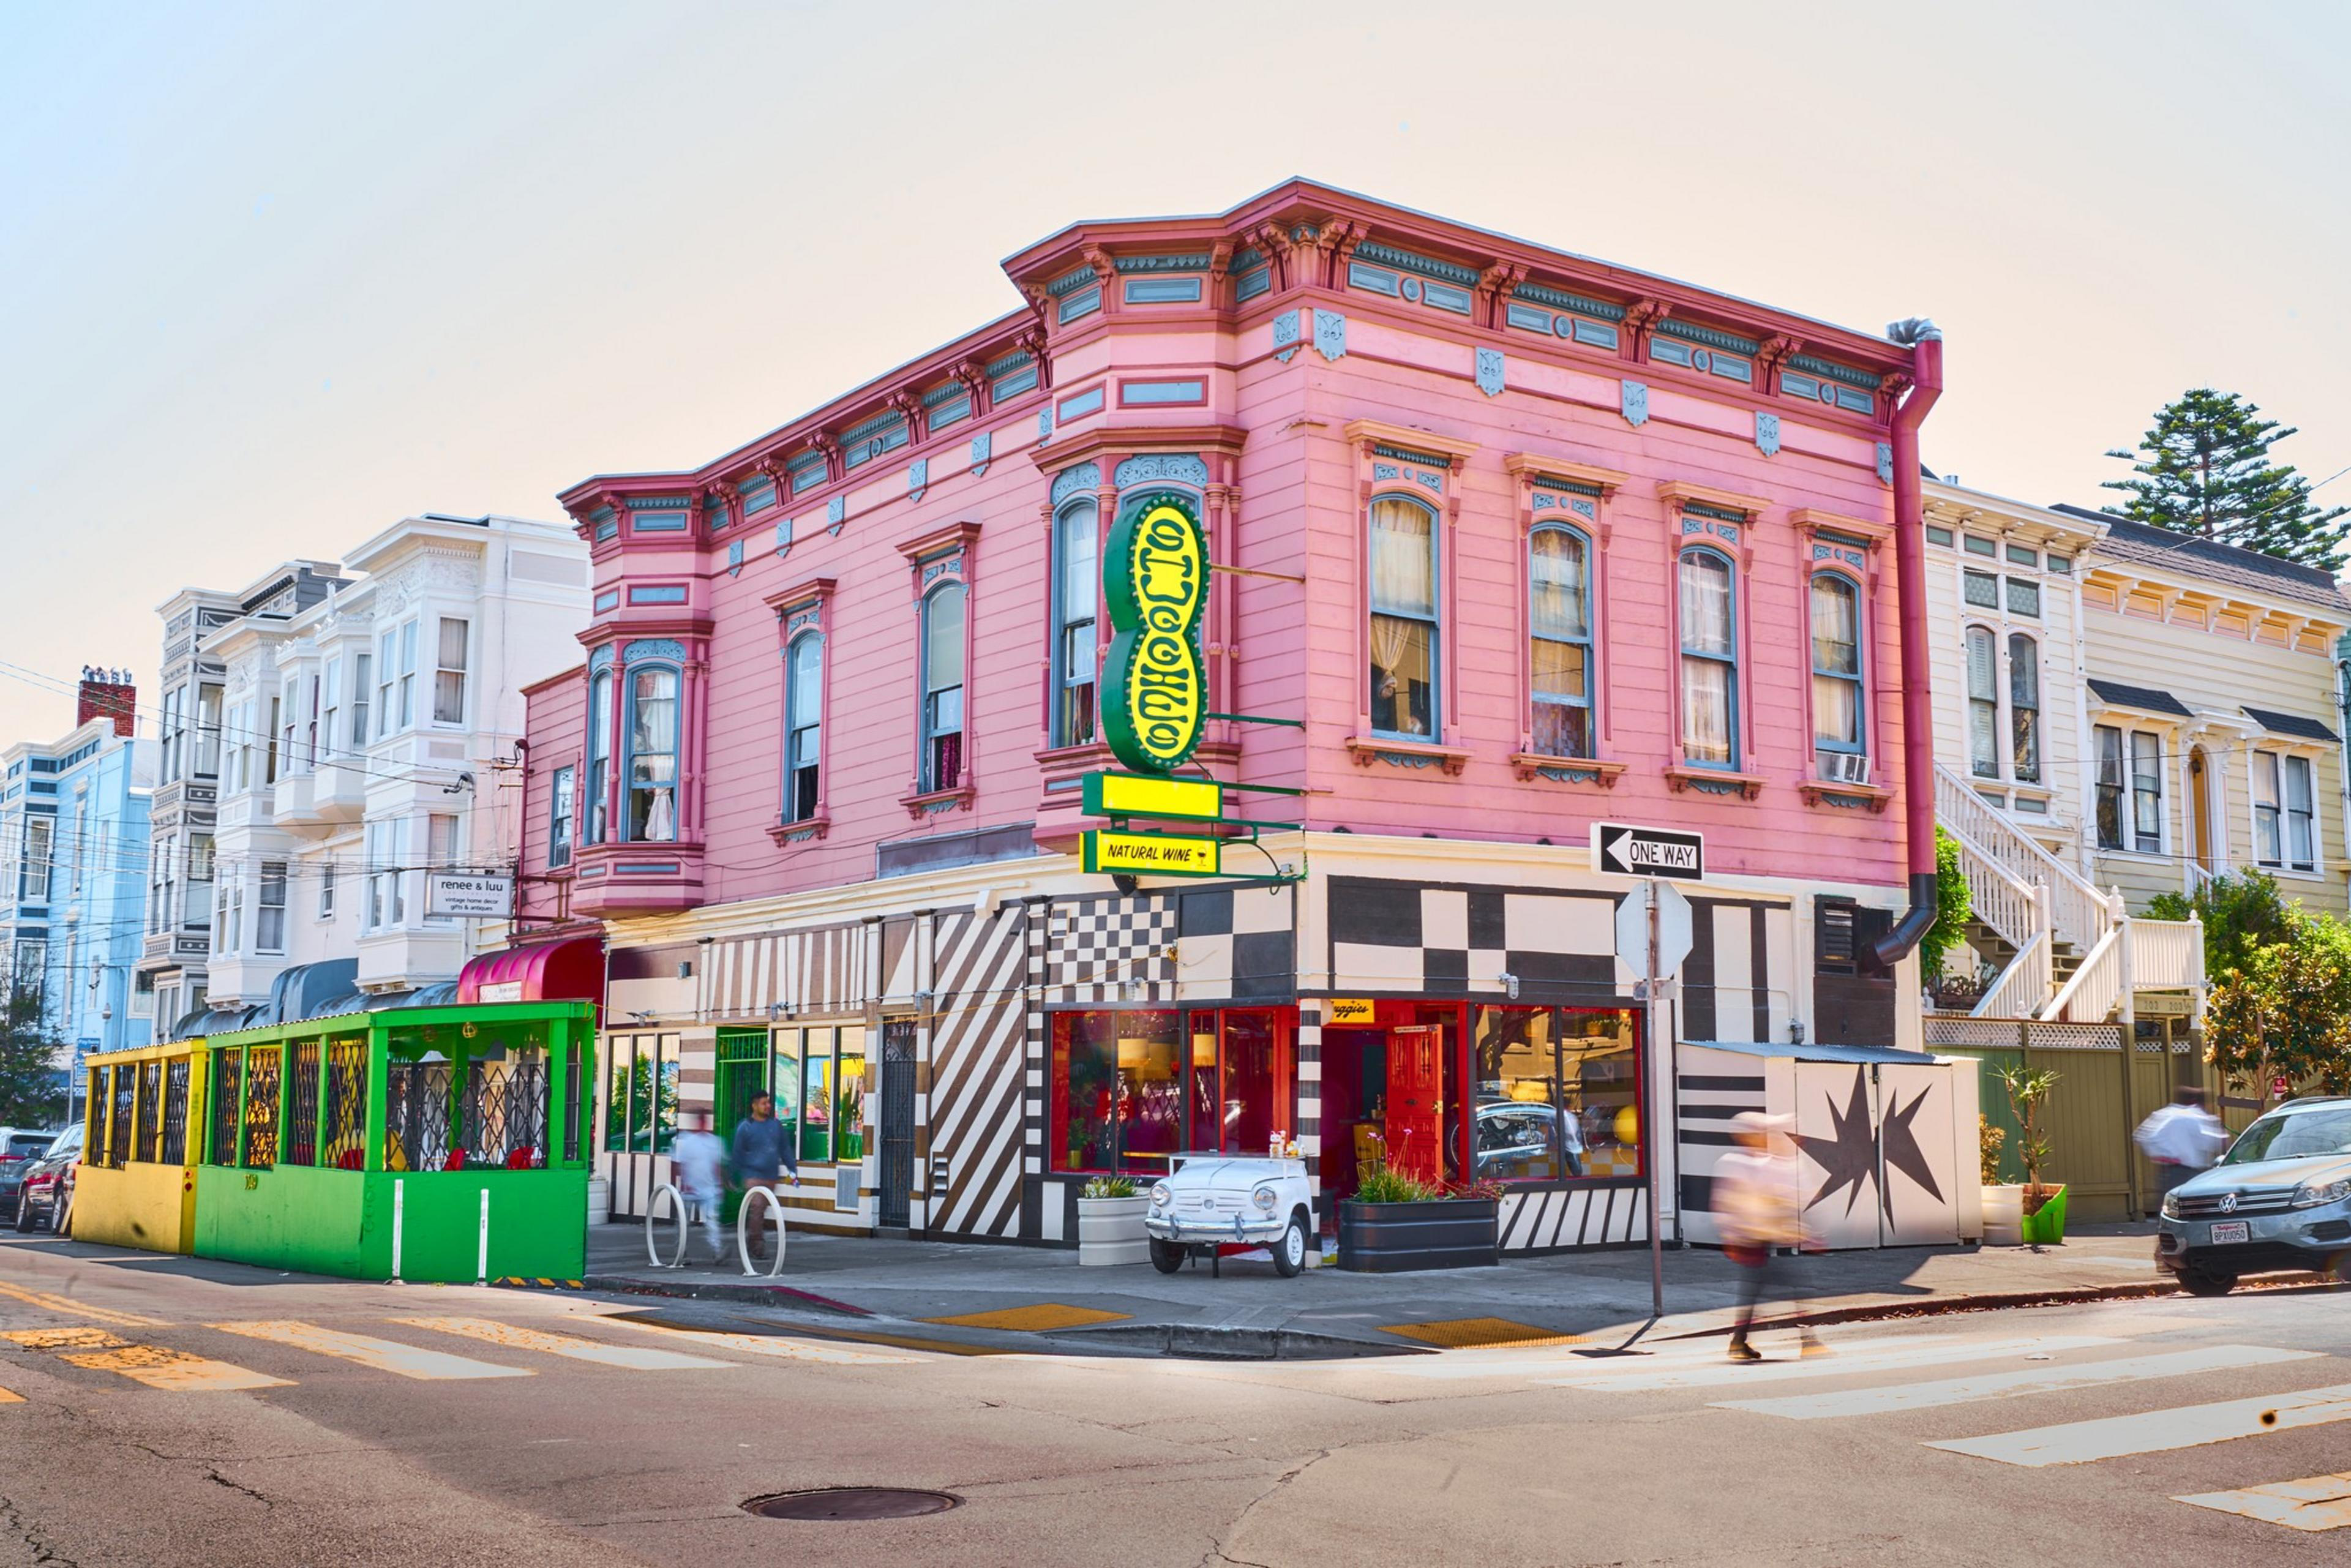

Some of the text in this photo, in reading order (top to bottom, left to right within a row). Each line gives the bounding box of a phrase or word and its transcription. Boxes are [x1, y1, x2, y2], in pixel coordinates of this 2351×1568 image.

[1108, 844, 1192, 862] NATURAL WINE
[1630, 842, 1693, 866] ONE WAY
[441, 881, 473, 890] renee
[486, 880, 503, 891] luu
[1333, 1003, 1369, 1019] uggies
[2214, 1229, 2246, 1242] 8PXU050
